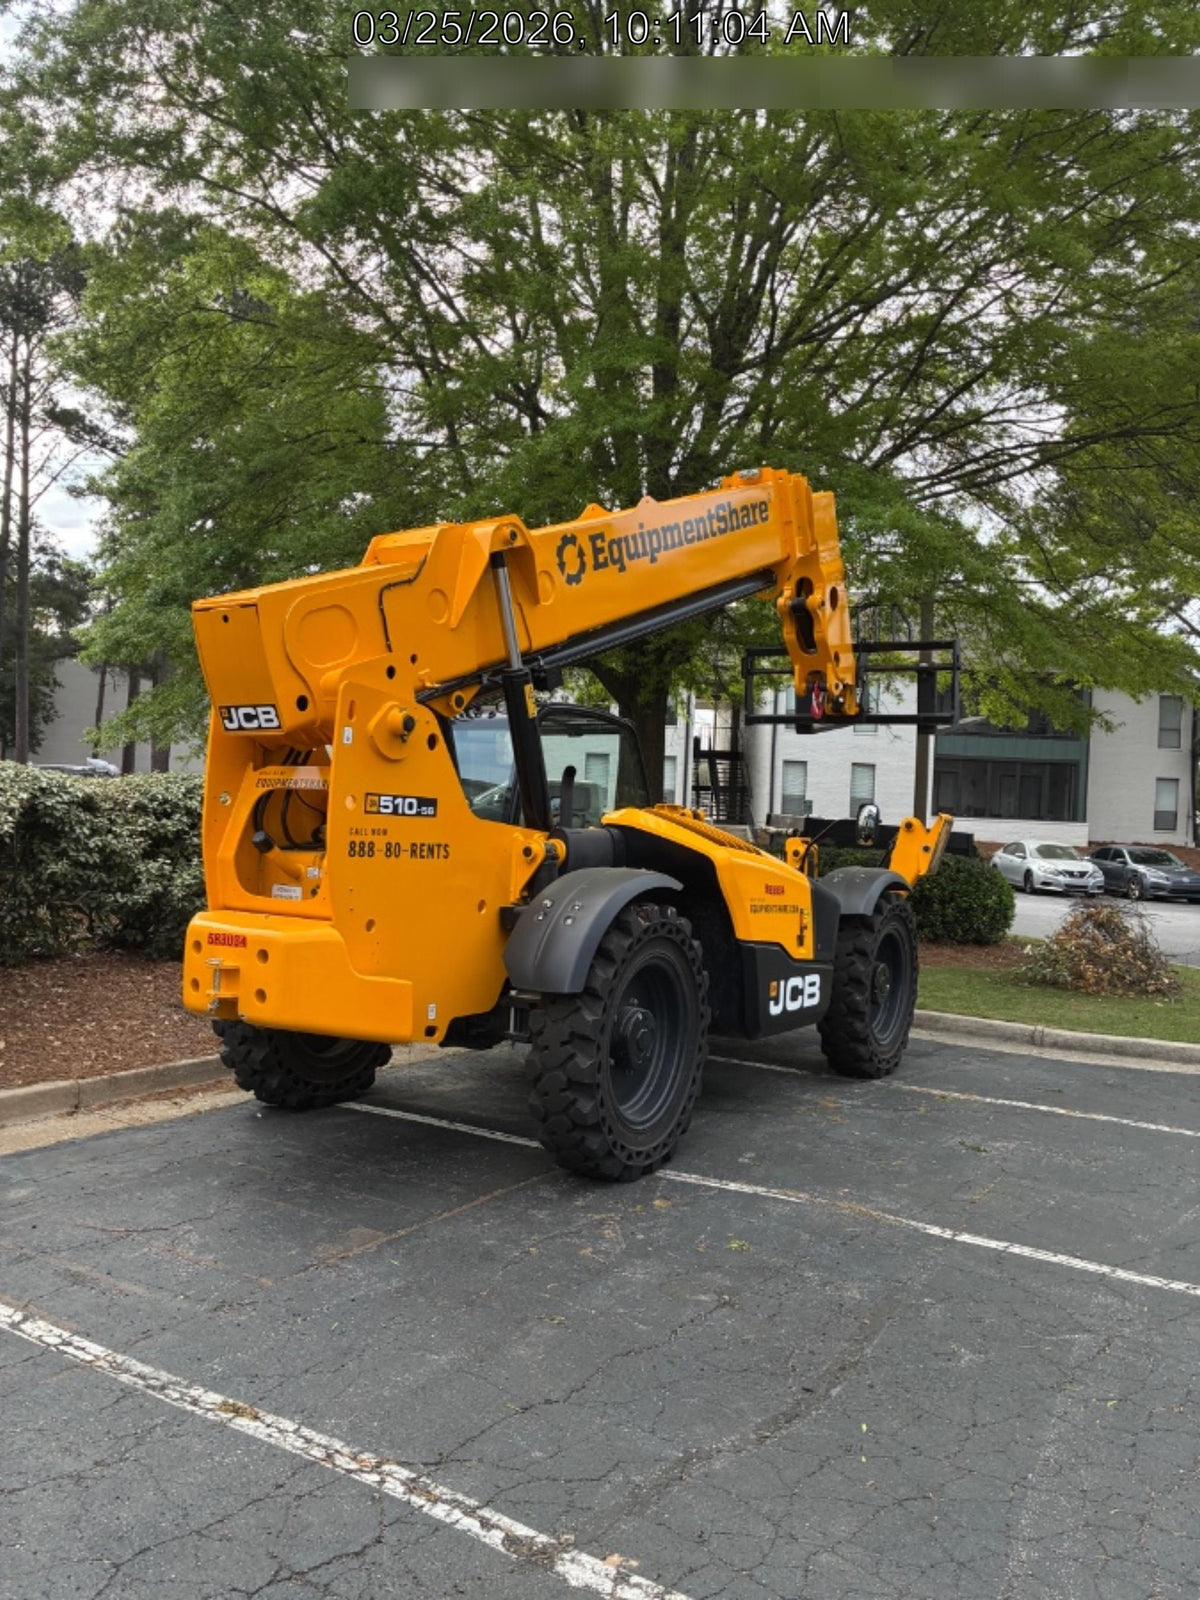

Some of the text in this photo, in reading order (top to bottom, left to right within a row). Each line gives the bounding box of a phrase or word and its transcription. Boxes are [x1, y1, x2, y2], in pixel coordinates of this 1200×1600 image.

[589, 500, 769, 573] EquipmentShare
[223, 706, 280, 729] JCB
[349, 828, 388, 836] CALL NOW
[348, 841, 450, 859] 888-80-RENTS
[769, 974, 820, 1016] JCB
